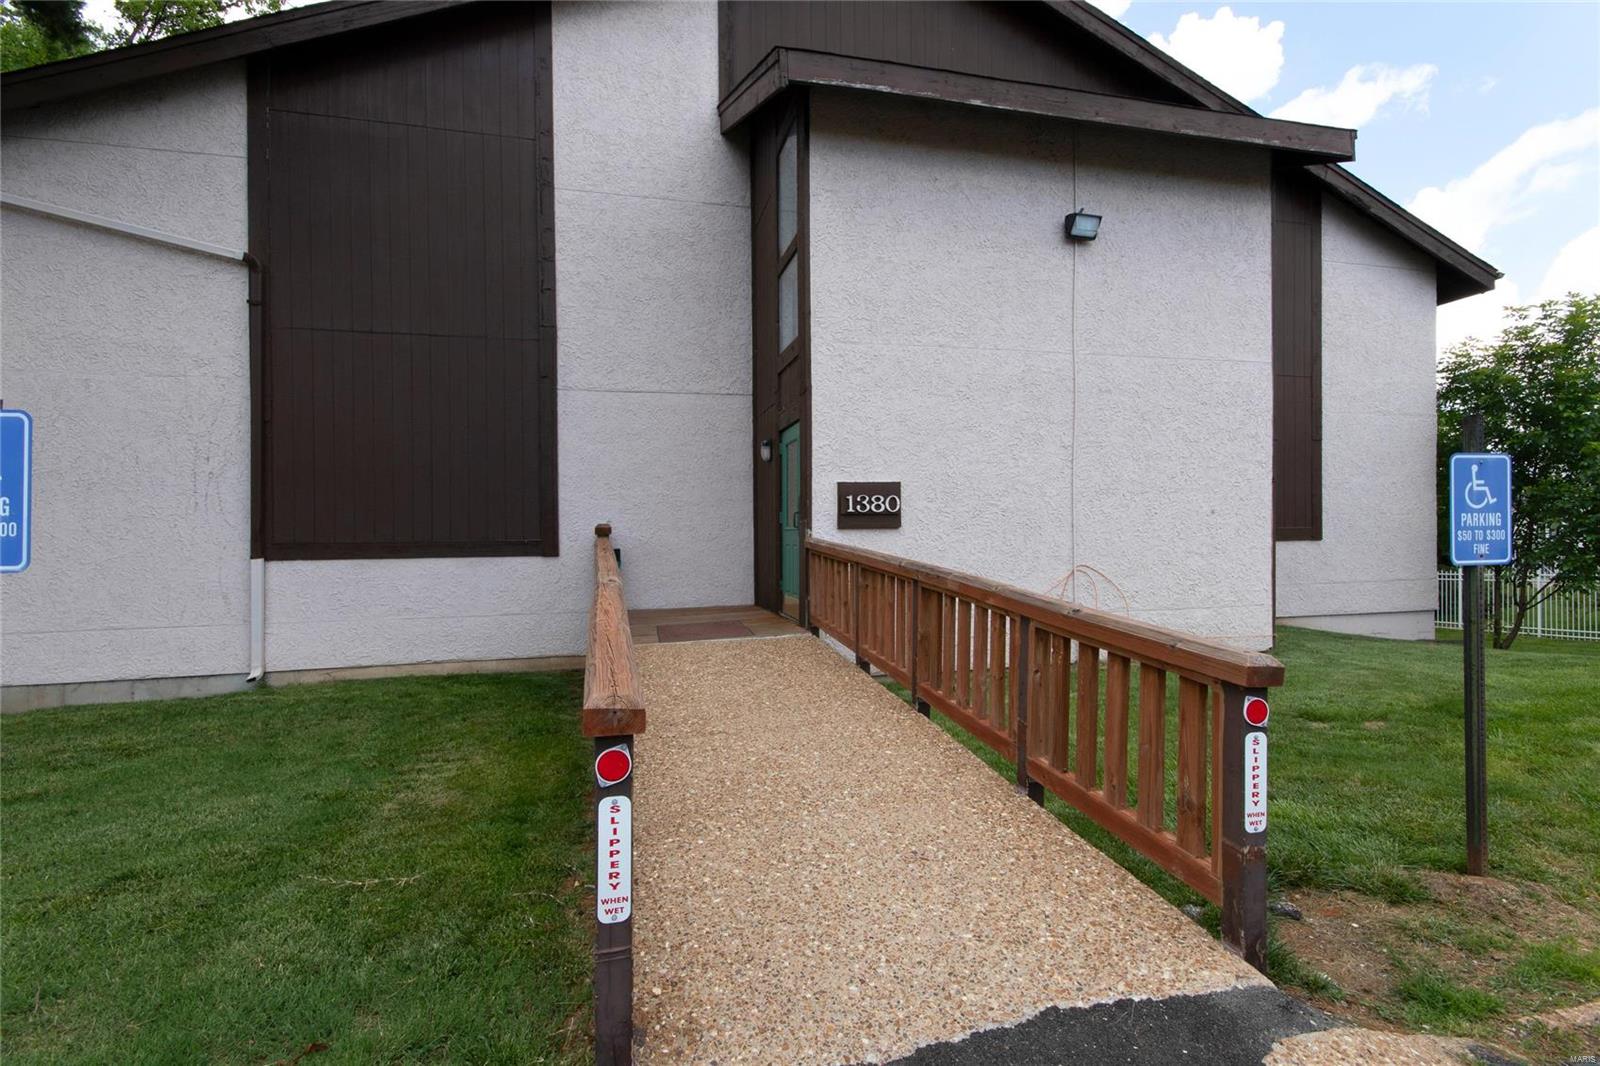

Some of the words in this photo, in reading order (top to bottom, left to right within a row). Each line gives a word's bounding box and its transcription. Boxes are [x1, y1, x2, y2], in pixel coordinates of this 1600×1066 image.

[846, 495, 900, 512] 1380
[1461, 512, 1502, 527] PARKING
[1457, 530, 1472, 541] $50
[1474, 530, 1484, 541] TO
[1486, 530, 1506, 540] $300
[1473, 543, 1490, 554] FINE
[1252, 739, 1260, 807] SLIPPERY
[609, 805, 621, 891] SLIPPERY
[600, 896, 629, 905] WHEN
[604, 907, 625, 915] WET
